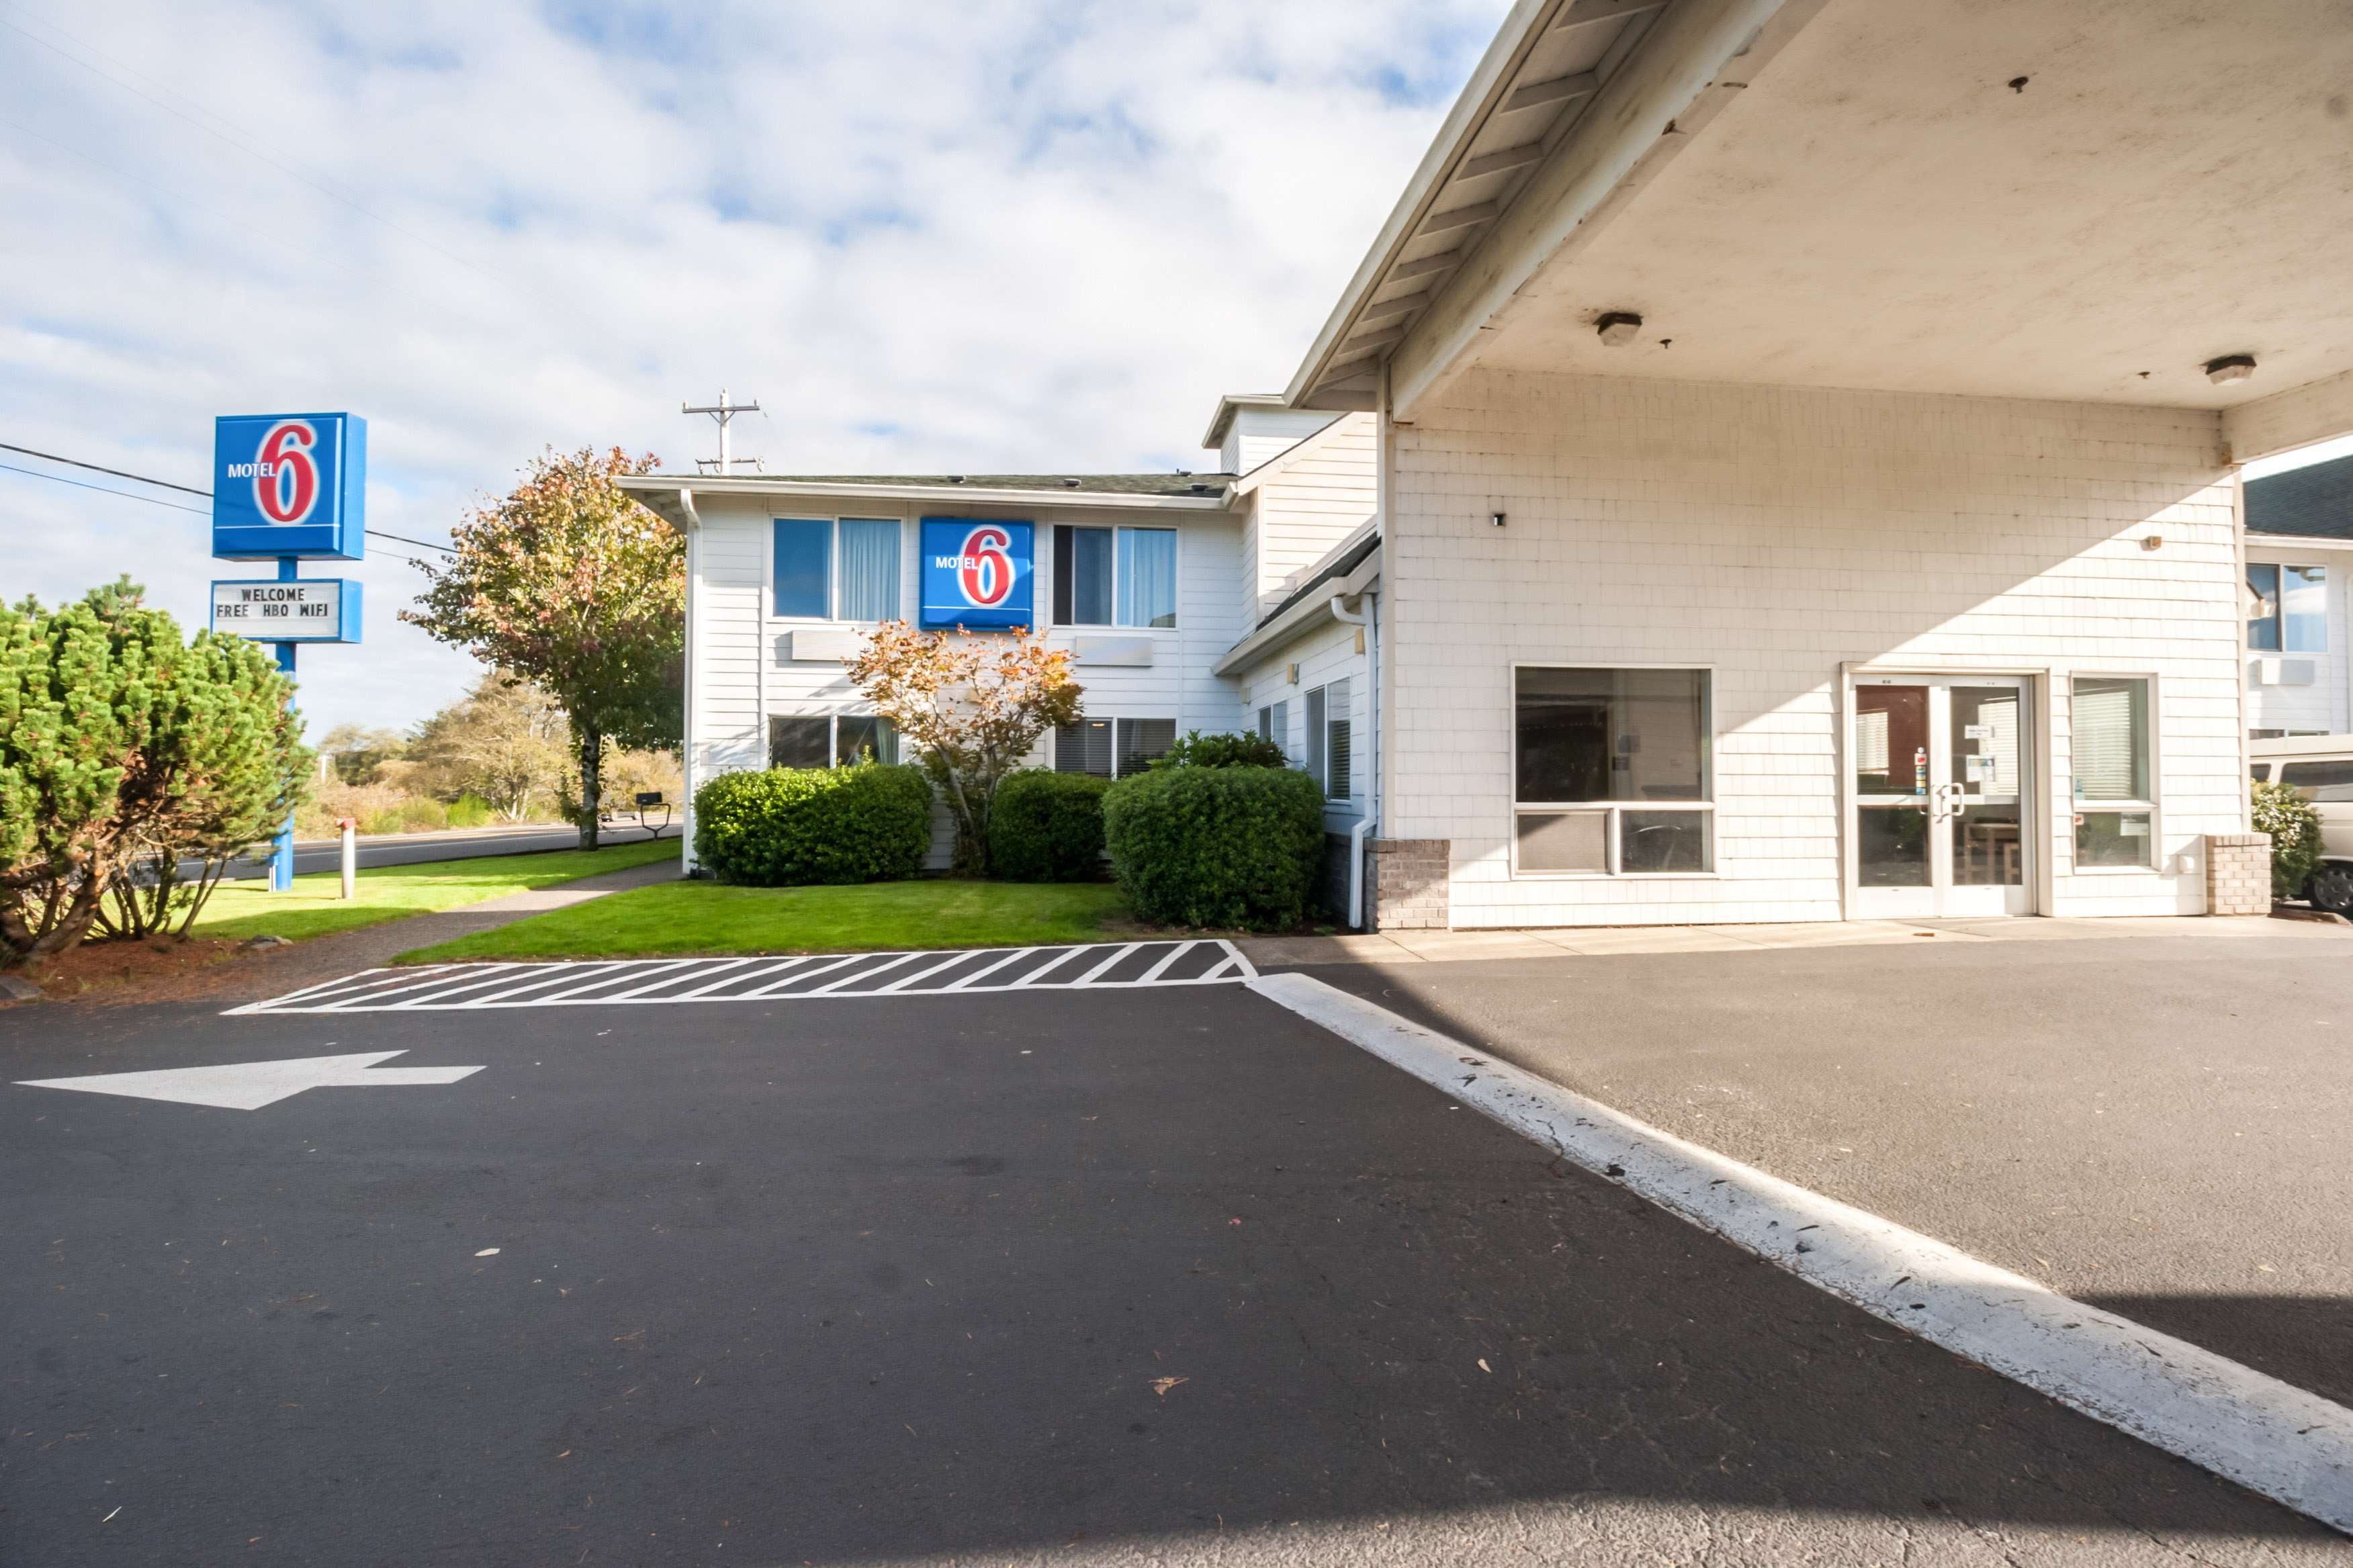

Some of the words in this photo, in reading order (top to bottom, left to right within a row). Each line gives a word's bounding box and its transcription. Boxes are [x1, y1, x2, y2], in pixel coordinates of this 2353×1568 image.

[228, 463, 277, 478] MOTEL
[257, 423, 315, 523] 6
[935, 557, 979, 569] MOTEL
[962, 528, 1010, 605] 6
[216, 604, 249, 618] FREE
[263, 604, 289, 617] HBO
[300, 603, 328, 616] WIFI
[242, 588, 305, 602] WELCOME
